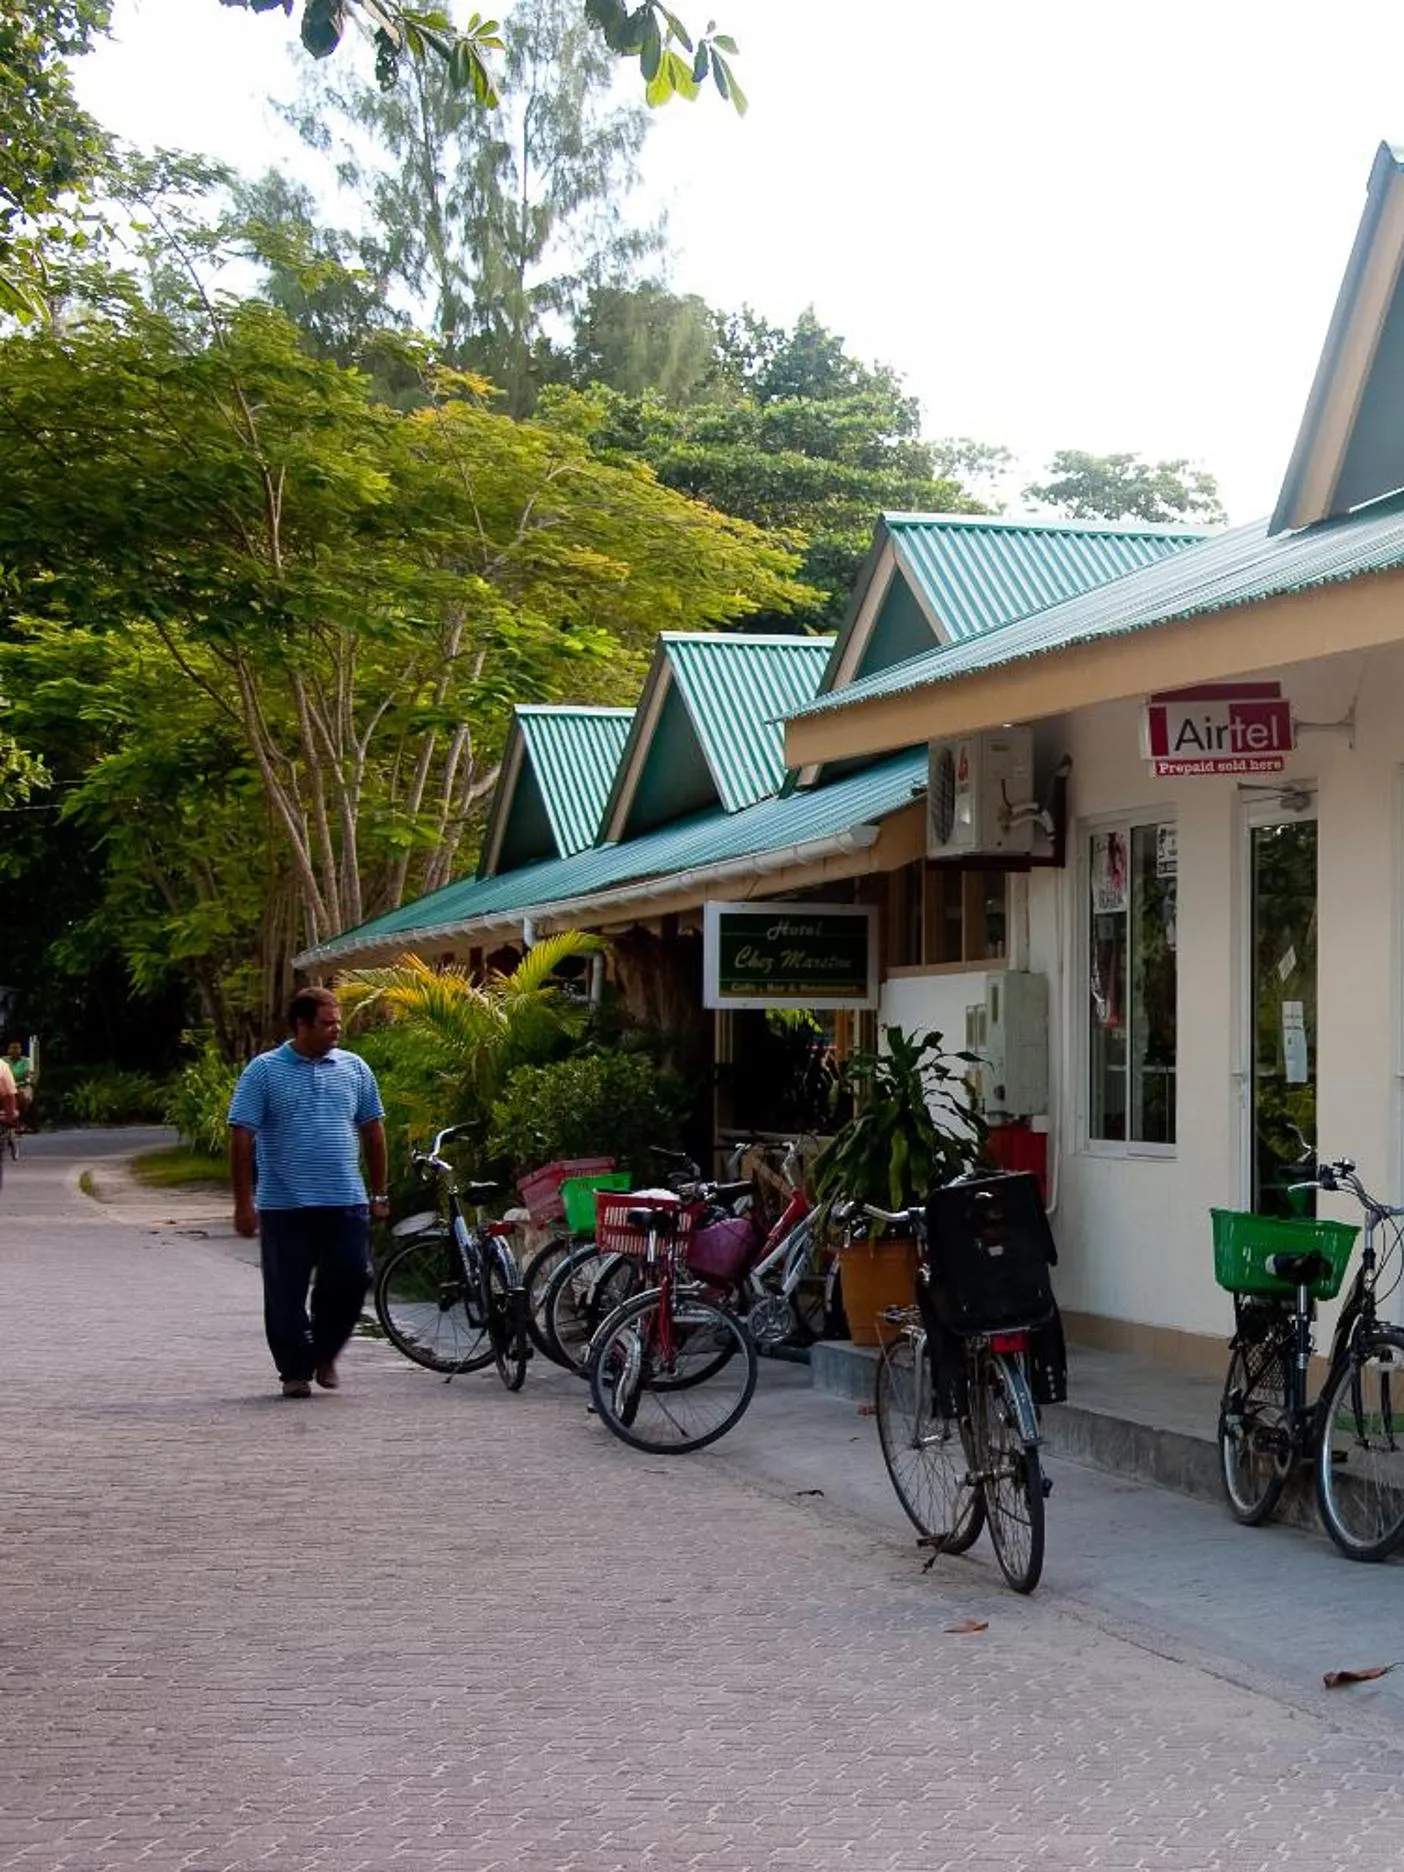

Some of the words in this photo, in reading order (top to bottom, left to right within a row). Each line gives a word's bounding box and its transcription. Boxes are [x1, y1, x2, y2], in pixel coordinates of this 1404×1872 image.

[1174, 714, 1279, 751] Airtel
[1158, 761, 1215, 775] Prepaid
[1217, 760, 1247, 772] sold
[1249, 759, 1282, 771] here
